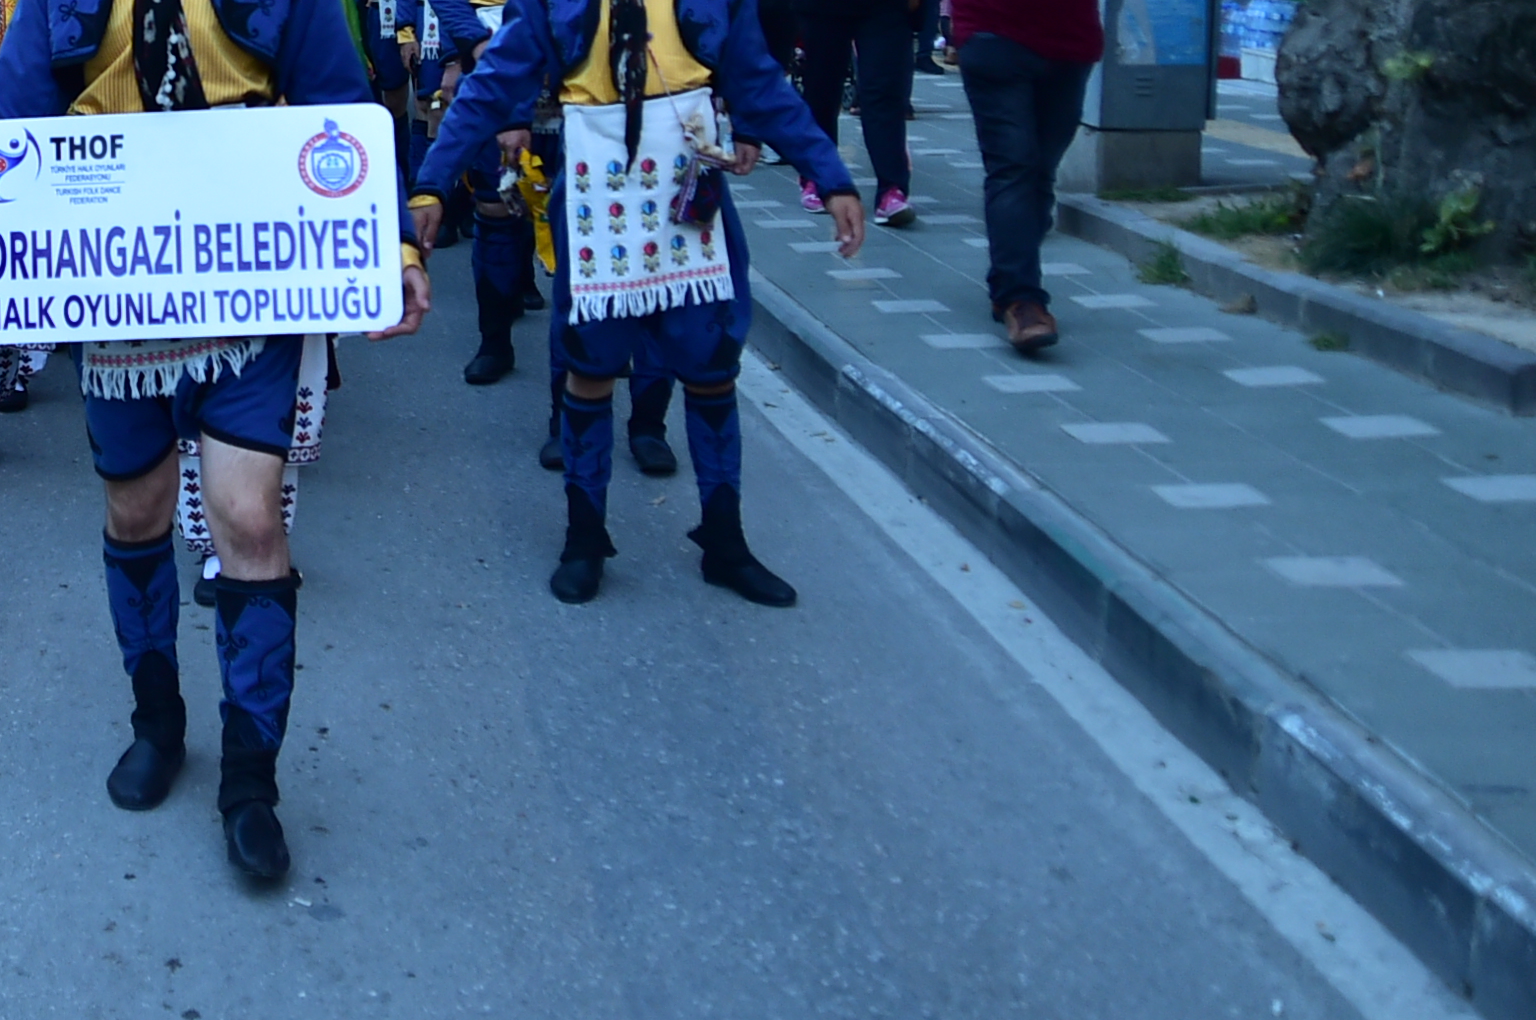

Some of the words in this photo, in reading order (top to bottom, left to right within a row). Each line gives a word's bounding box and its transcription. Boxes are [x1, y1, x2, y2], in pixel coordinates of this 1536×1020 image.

[49, 134, 124, 162] THOF
[78, 164, 93, 172] HALK
[56, 187, 82, 196] TURKISH
[101, 186, 121, 194] DANCE
[69, 196, 108, 205] FEDERATION
[194, 203, 380, 273] BELEDİYESİ
[63, 291, 206, 329] OYUNLARI
[214, 277, 381, 324] TOPLULUĞU
